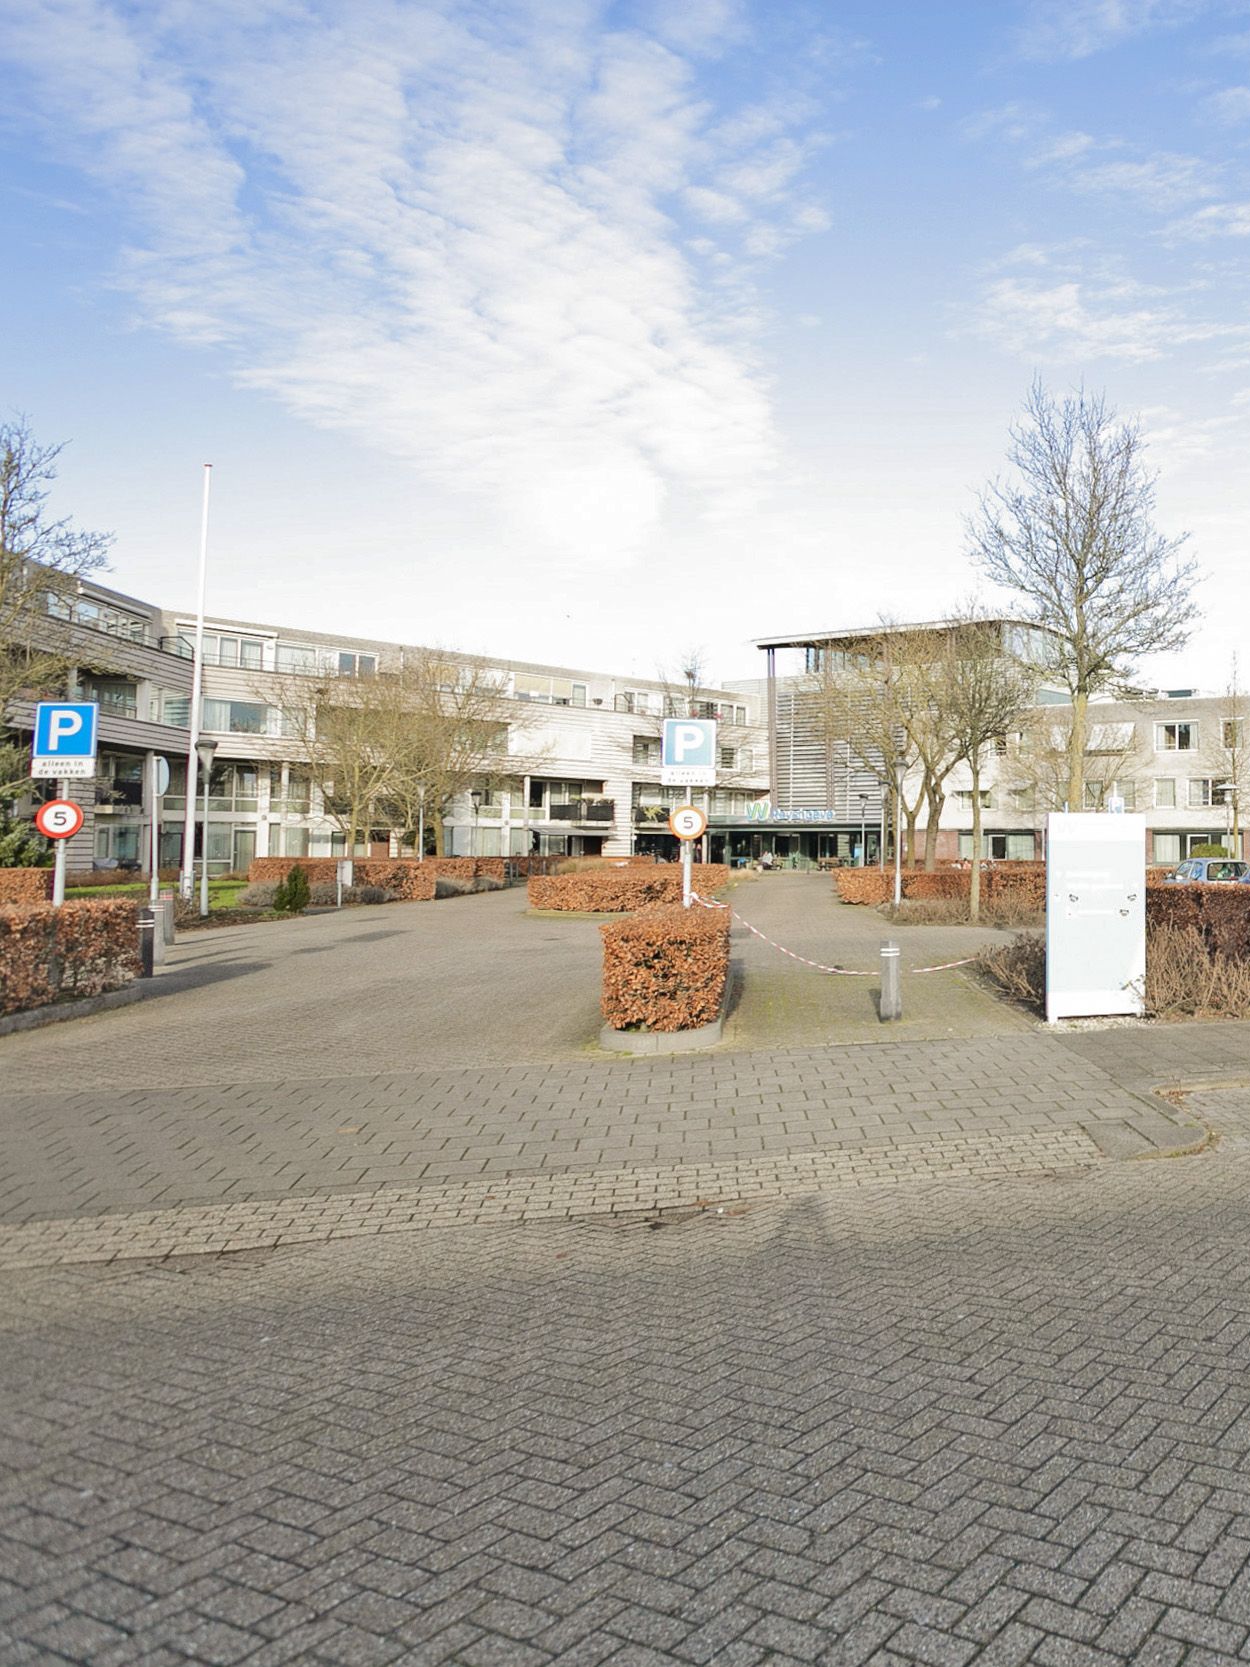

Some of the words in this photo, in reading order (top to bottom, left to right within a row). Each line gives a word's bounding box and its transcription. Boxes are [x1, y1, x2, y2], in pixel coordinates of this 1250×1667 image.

[48, 710, 82, 751] P
[675, 725, 704, 762] P
[53, 811, 67, 826] 5
[683, 817, 693, 829] 5
